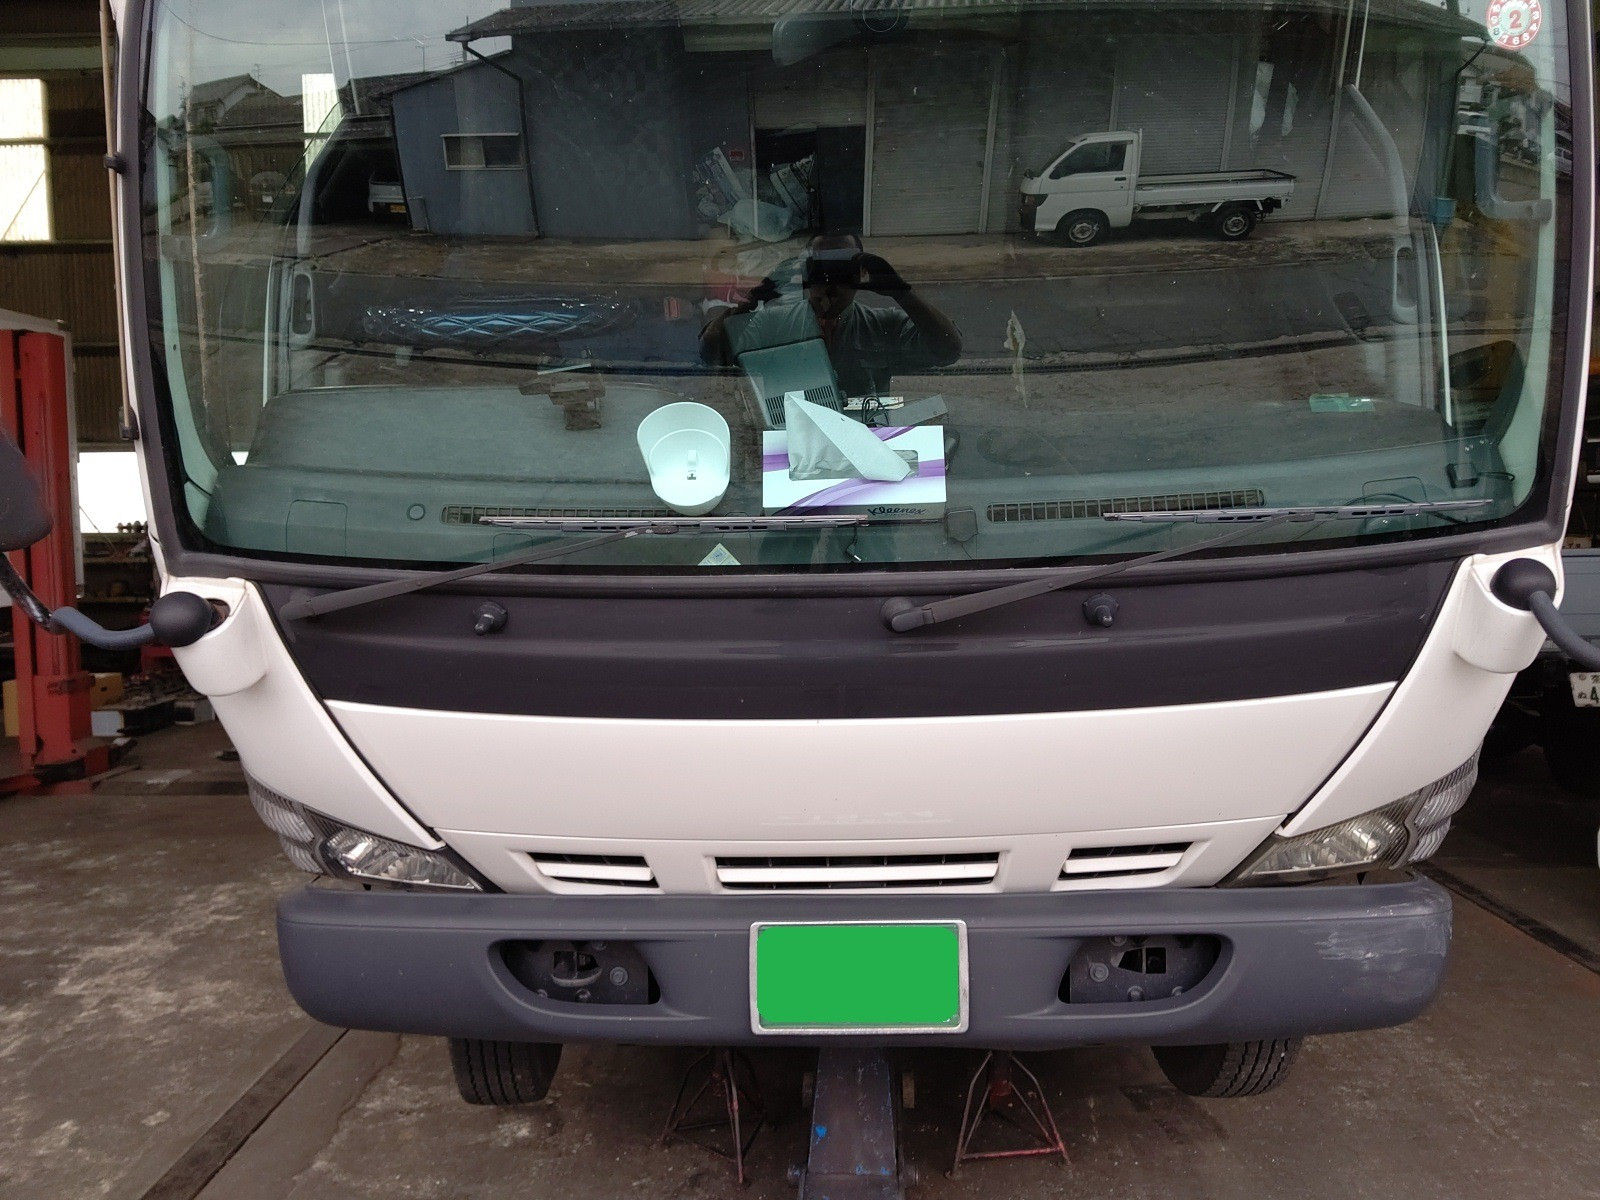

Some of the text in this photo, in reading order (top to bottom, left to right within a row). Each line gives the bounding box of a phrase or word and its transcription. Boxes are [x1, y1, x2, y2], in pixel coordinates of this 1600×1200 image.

[1509, 10, 1522, 28] 2
[1532, 11, 1540, 20] 3
[1491, 16, 1498, 24] 9
[1530, 23, 1537, 31] 4
[1501, 35, 1509, 43] 7
[1512, 36, 1520, 45] 6
[1522, 33, 1530, 41] 5
[867, 506, 926, 516] Kleenex
